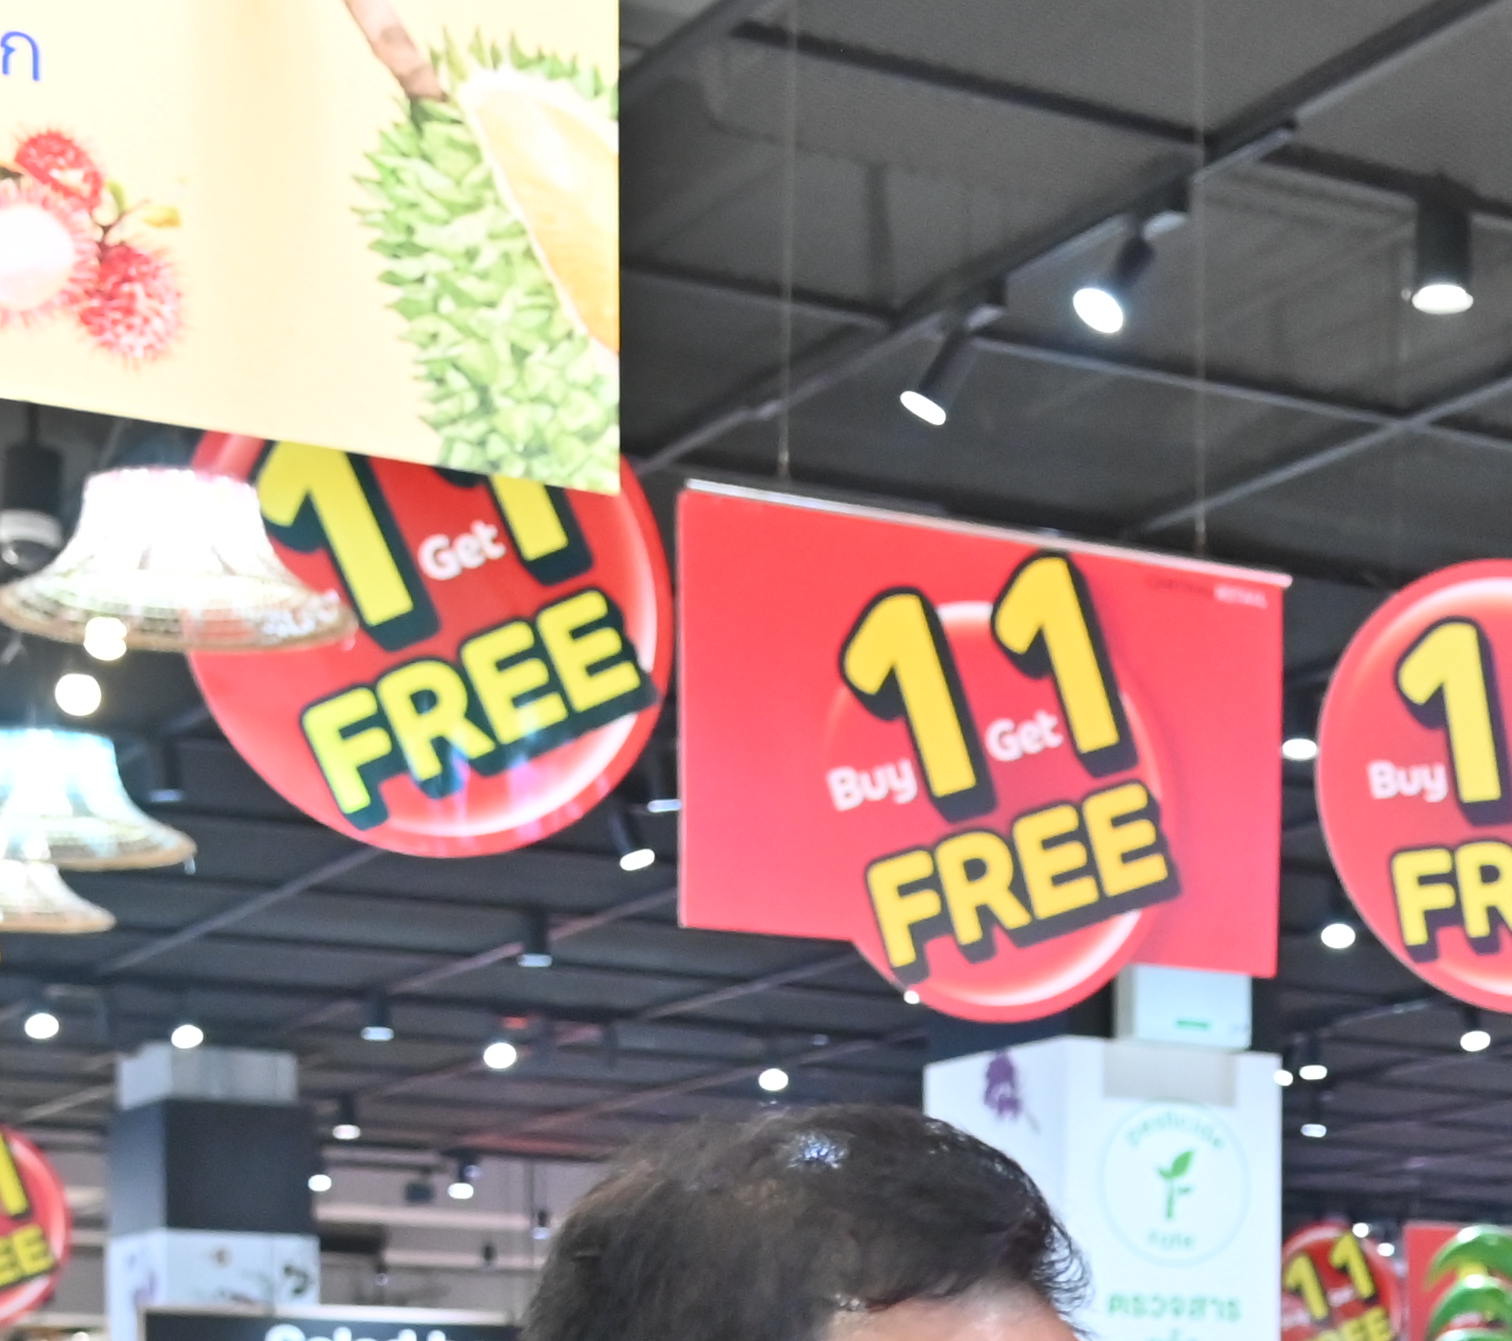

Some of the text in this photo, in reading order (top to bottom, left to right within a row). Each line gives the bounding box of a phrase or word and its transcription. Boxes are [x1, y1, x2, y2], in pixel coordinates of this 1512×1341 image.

[417, 520, 506, 582] Get
[300, 589, 642, 816] FREE
[826, 554, 1121, 812] Buy 1 Get 1
[1396, 619, 1502, 804] 1
[1366, 758, 1449, 804] Buy
[865, 782, 1170, 969] FREE
[1329, 1229, 1375, 1300] 1
